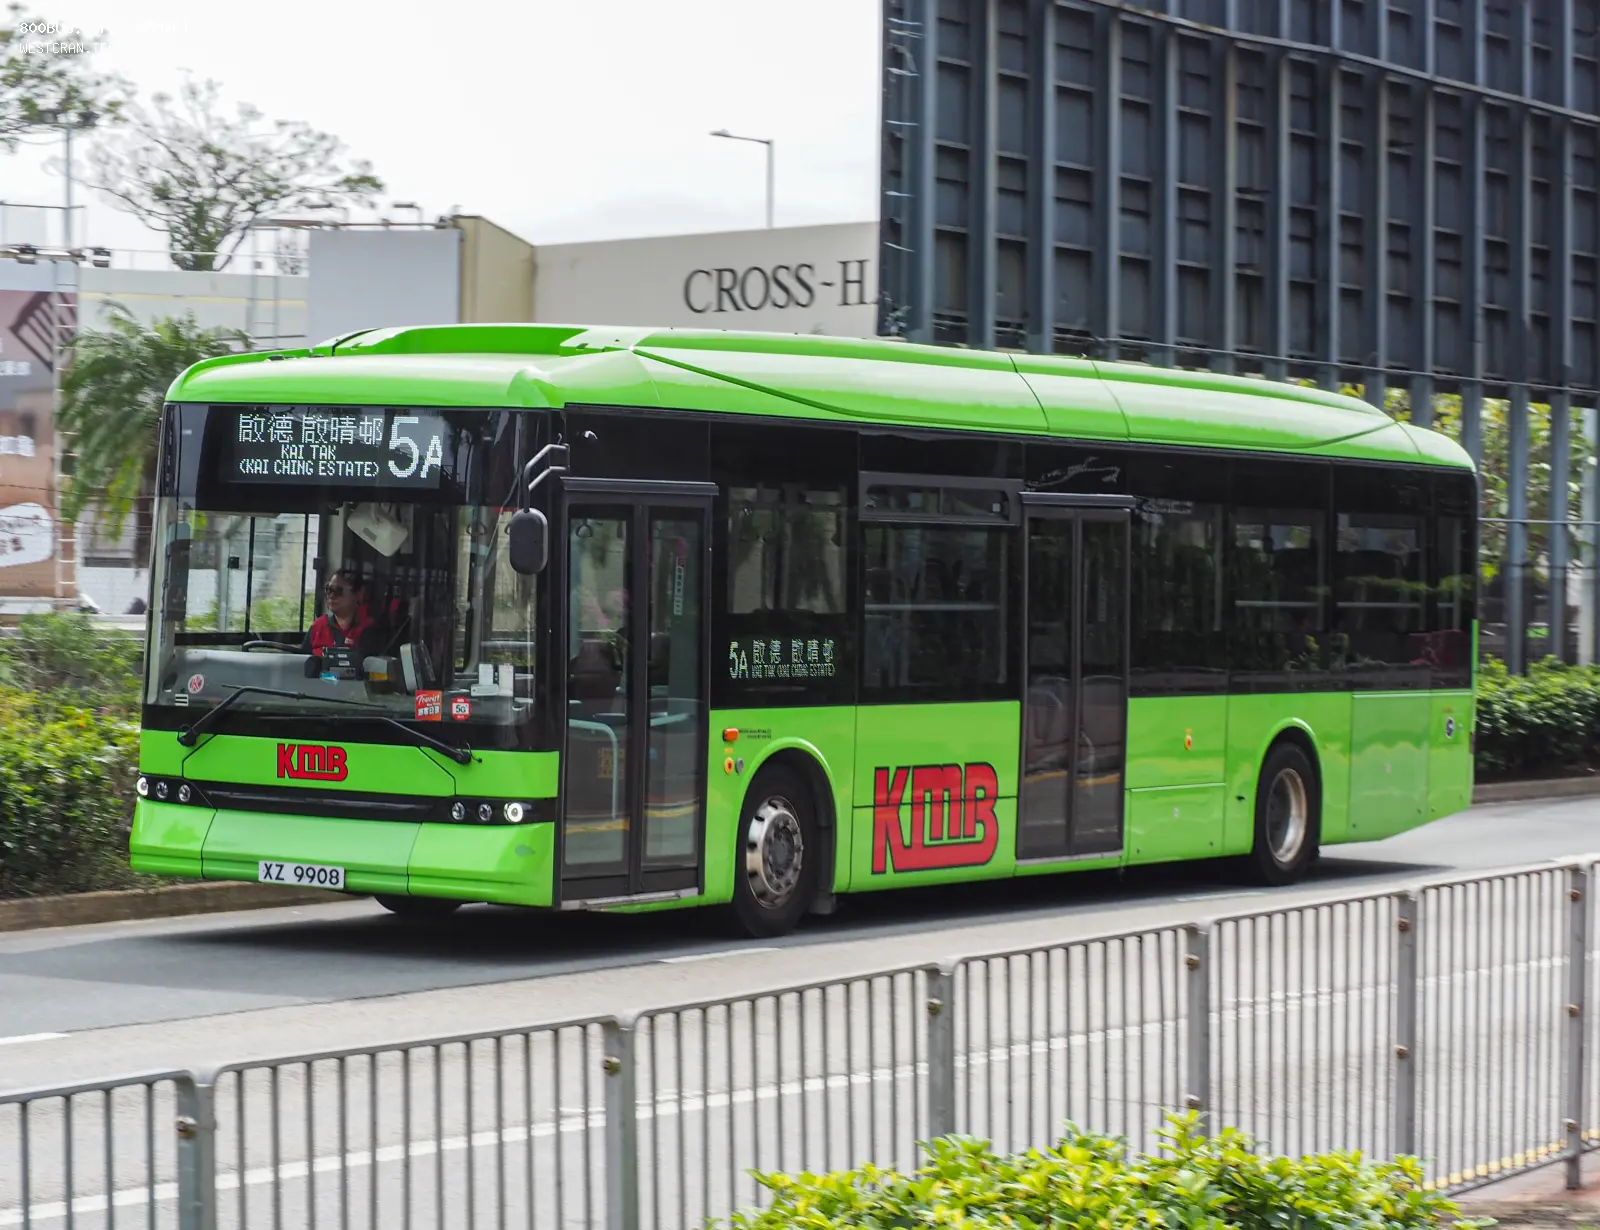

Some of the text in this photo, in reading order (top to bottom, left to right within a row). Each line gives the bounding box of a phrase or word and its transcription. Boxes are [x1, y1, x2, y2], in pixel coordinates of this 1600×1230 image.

[683, 258, 878, 314] CROSS-H
[281, 444, 337, 461] KAI TAK
[387, 416, 443, 478] 5A
[239, 458, 380, 478] (KAI CHING ESTATE)
[729, 641, 749, 679] 5A
[277, 743, 349, 782] KMB
[871, 762, 999, 875] KMB
[263, 863, 340, 886] XZ 9908
